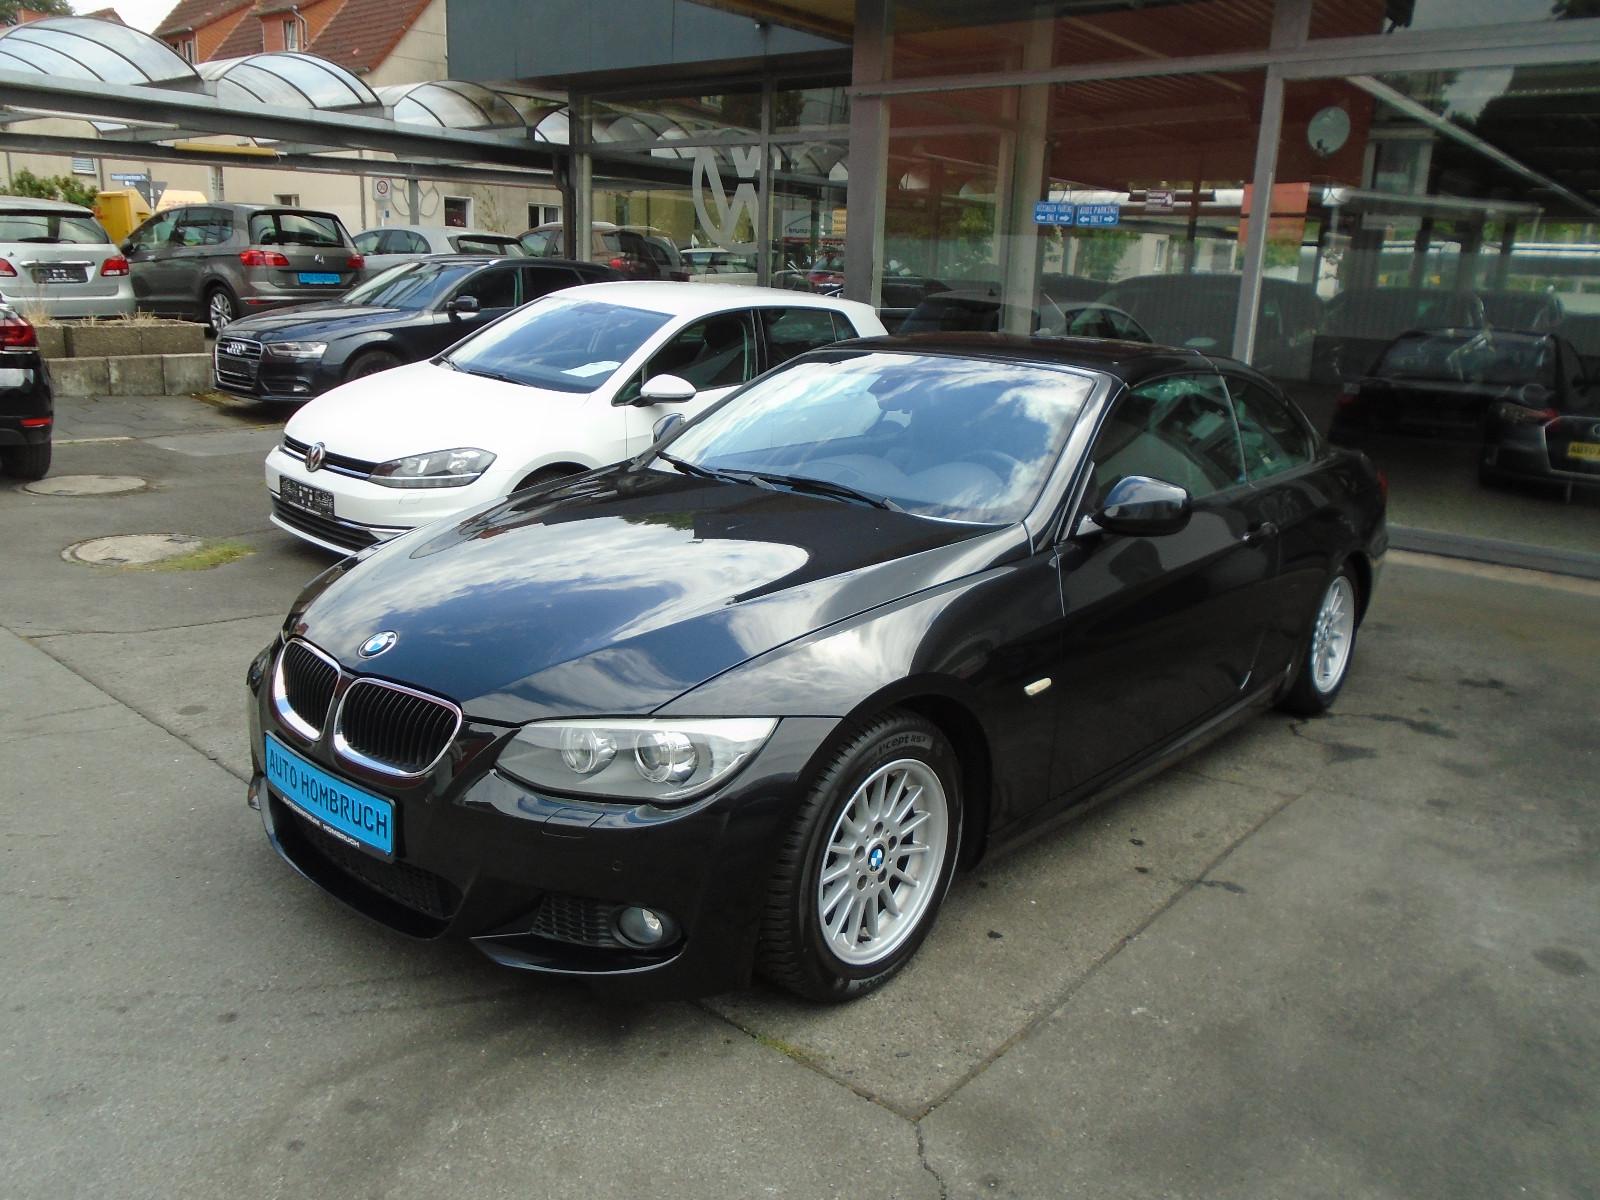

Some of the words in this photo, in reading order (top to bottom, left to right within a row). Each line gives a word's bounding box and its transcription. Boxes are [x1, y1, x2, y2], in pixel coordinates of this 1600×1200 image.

[270, 749, 297, 789] AUTO
[301, 771, 388, 840] HOMBRUCH
[322, 823, 360, 848] HOMBRUCH
